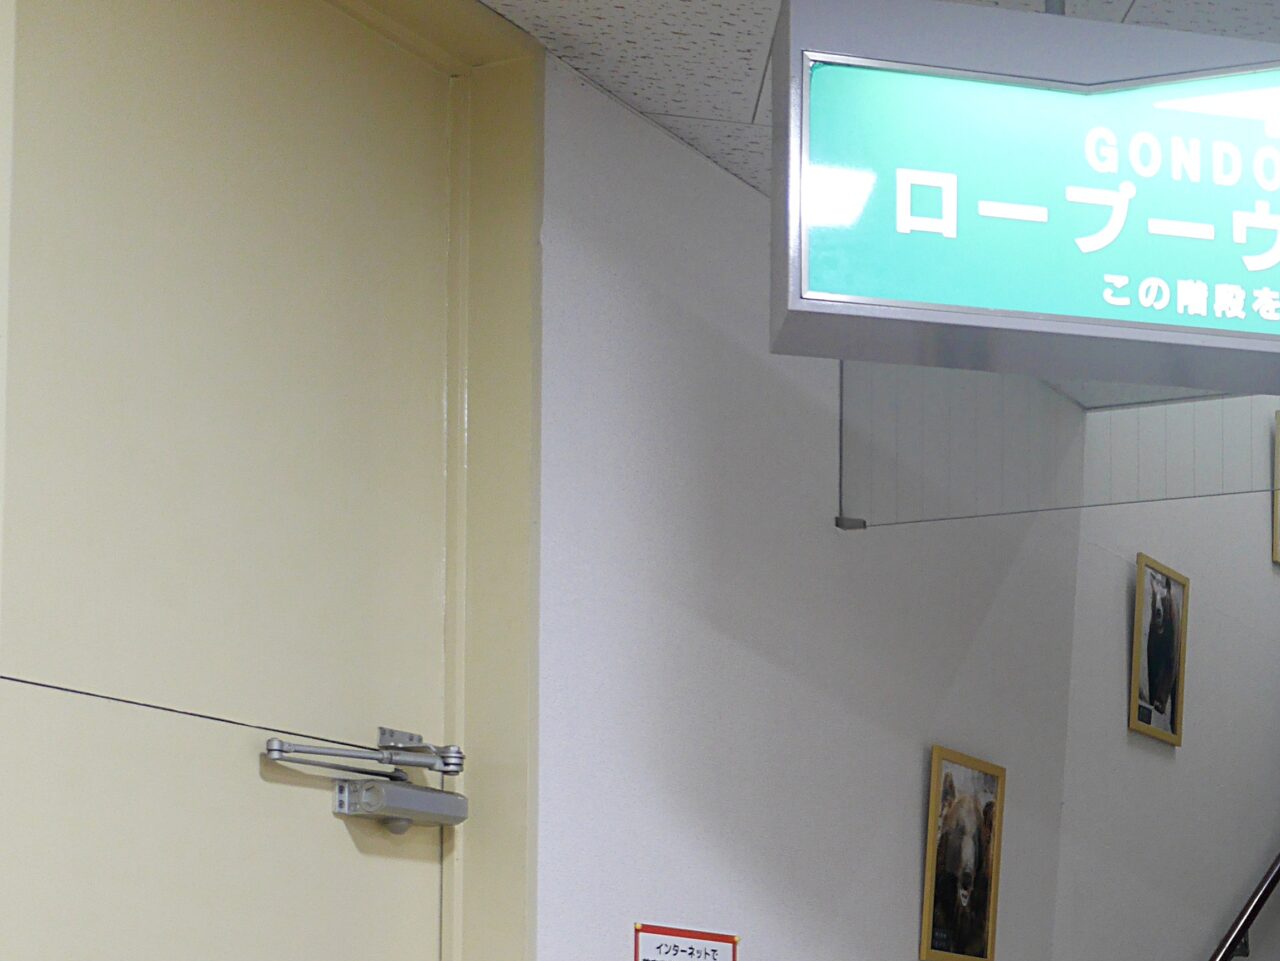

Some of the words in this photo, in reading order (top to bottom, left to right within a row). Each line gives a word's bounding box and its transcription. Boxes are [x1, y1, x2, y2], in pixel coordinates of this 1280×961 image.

[655, 943, 719, 961] インターネットで
